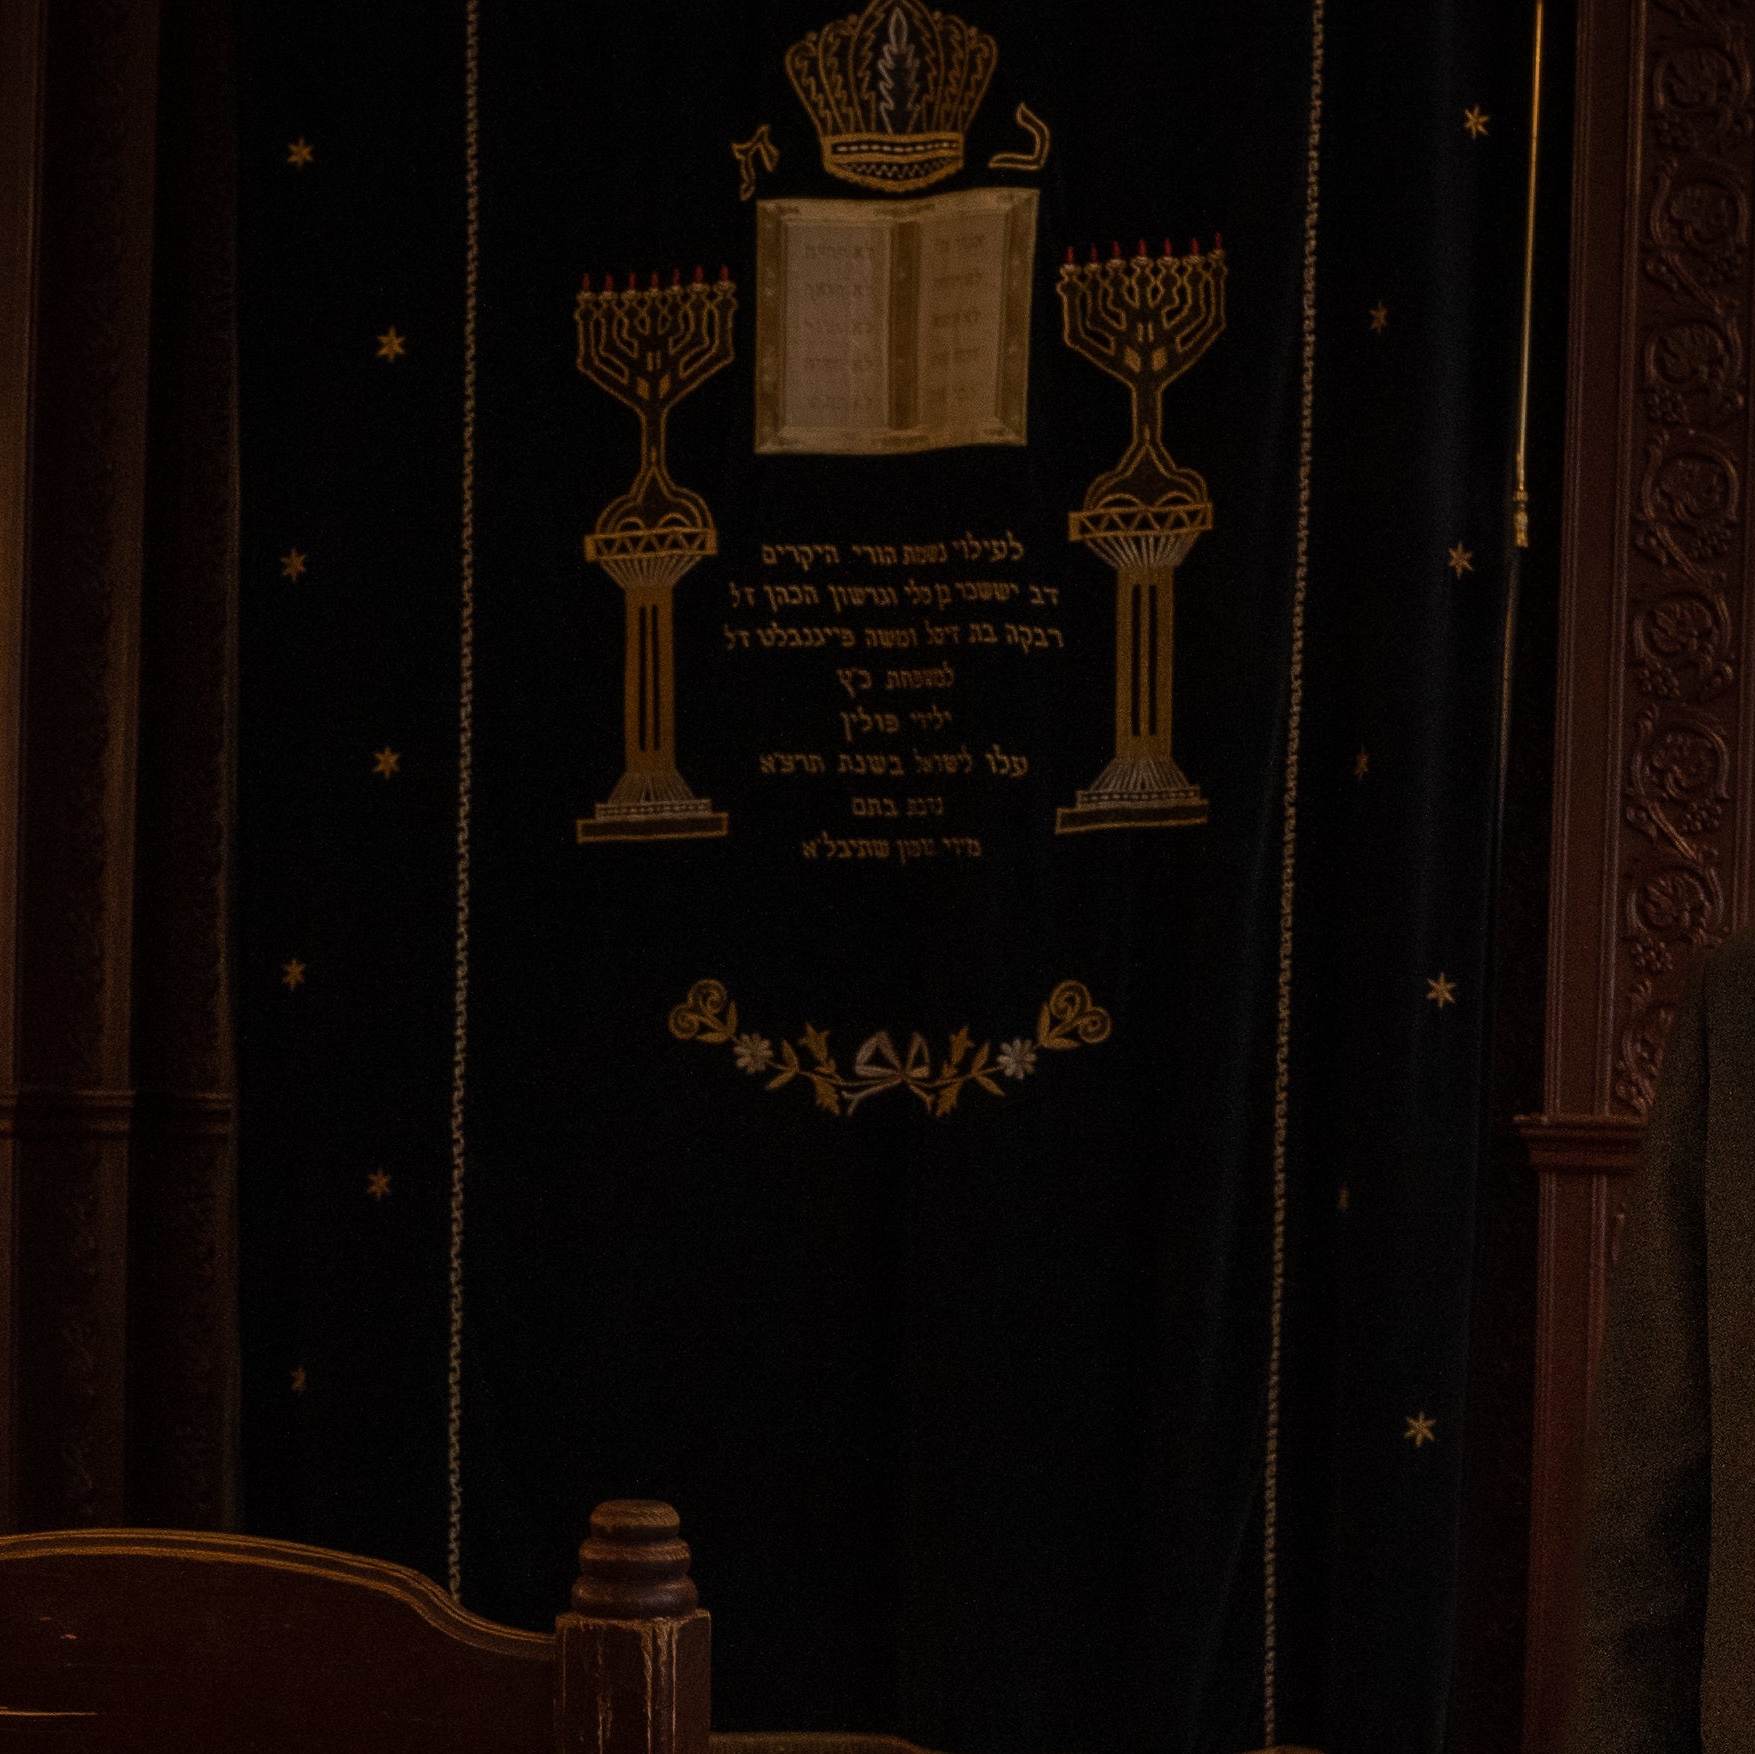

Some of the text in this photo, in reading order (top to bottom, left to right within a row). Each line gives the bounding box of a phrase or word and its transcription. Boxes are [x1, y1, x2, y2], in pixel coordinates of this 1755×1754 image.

[762, 545, 839, 571] היקרים
[852, 545, 897, 565] הורי
[952, 531, 1024, 561] לעילוי
[763, 585, 819, 612] הכהן
[865, 628, 917, 648] ומשה
[1005, 623, 1064, 653] רבקה
[840, 706, 899, 741] פולין
[838, 754, 904, 776] בשנת
[985, 744, 1028, 777] עלו
[852, 798, 898, 817] בתם
